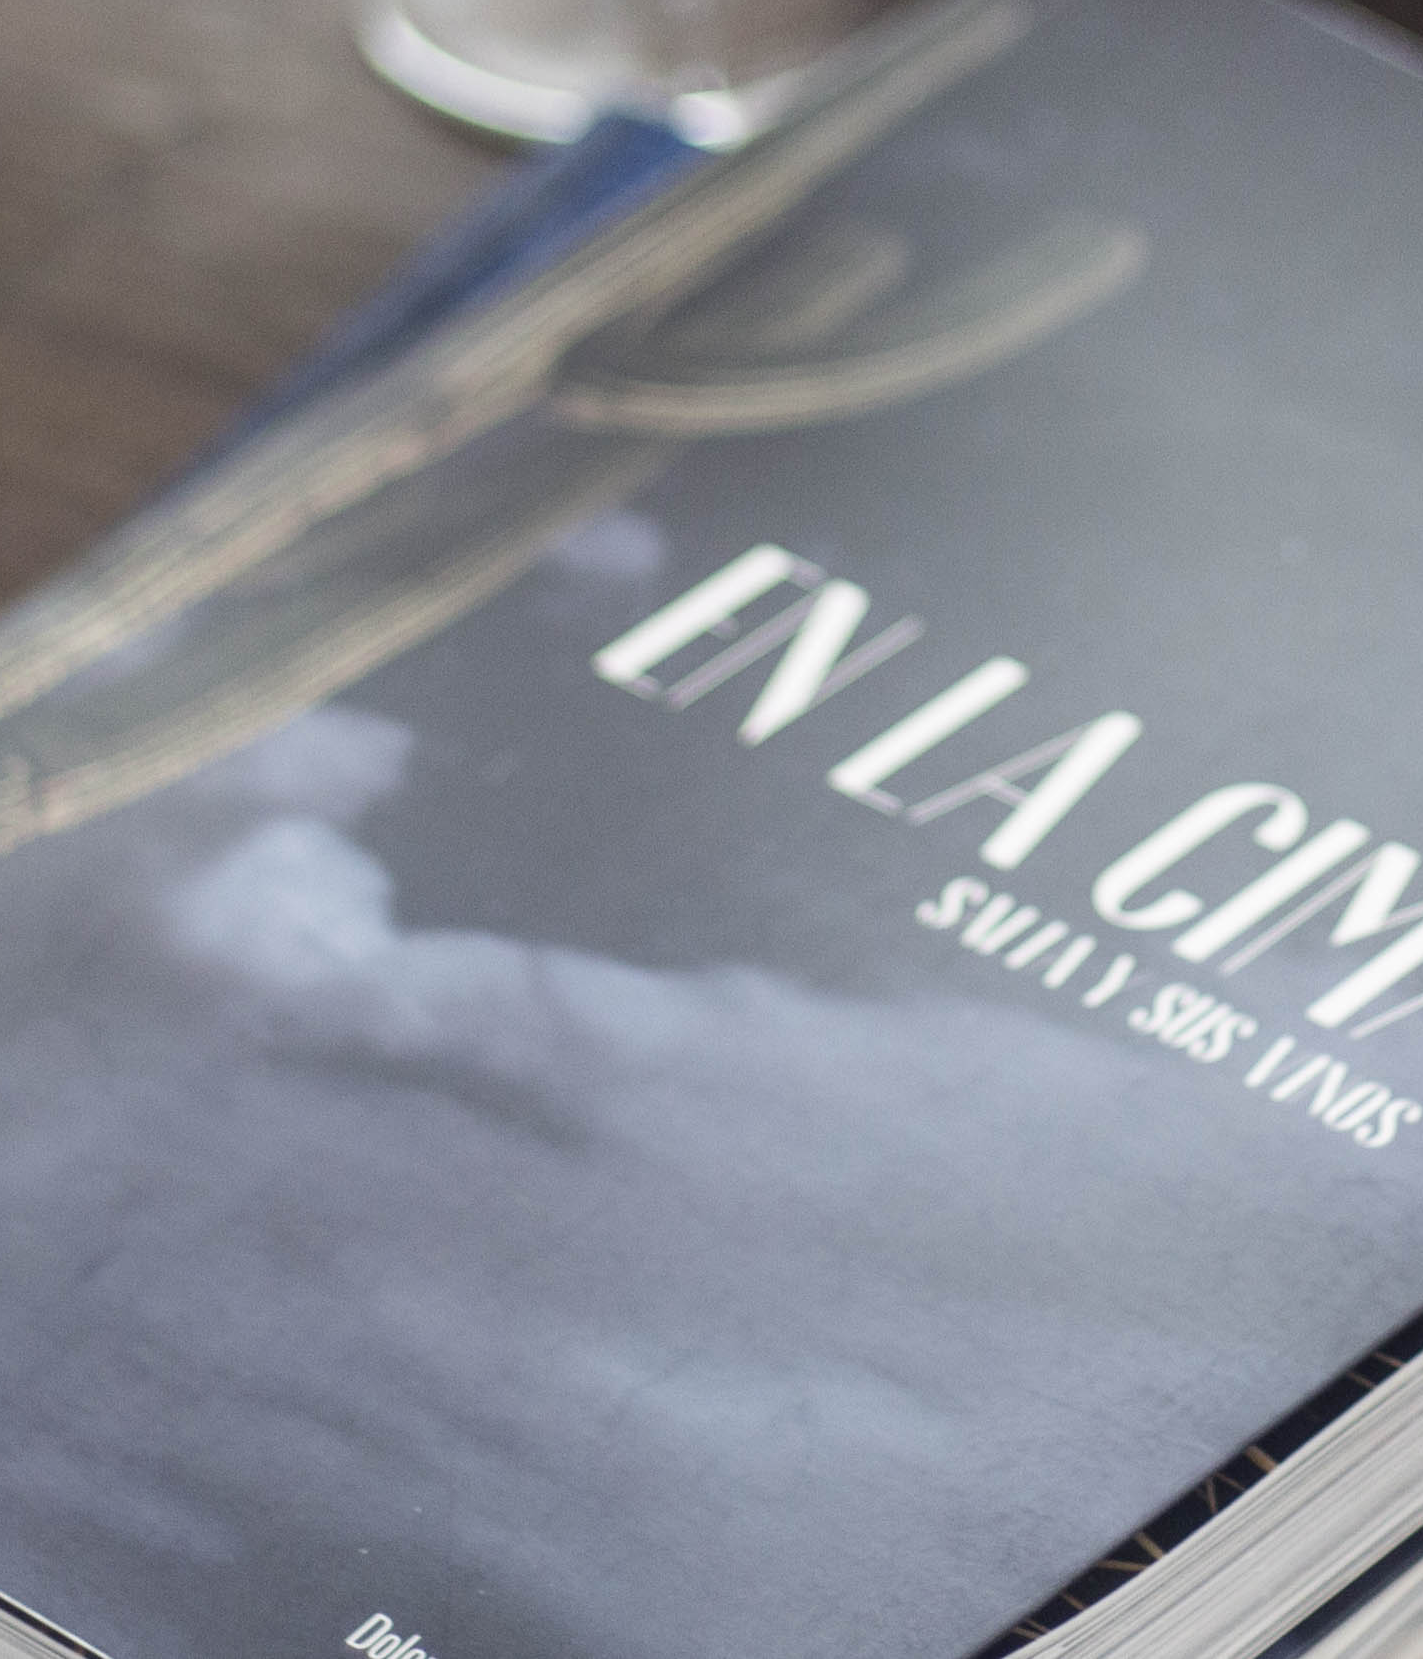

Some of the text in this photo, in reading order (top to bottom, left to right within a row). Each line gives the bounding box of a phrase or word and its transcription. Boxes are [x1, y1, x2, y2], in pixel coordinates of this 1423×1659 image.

[590, 542, 927, 748] EN
[825, 654, 1144, 871] LA
[1081, 952, 1154, 1009] Y
[1128, 982, 1259, 1064] SUS
[1242, 1034, 1423, 1149] VINOS
